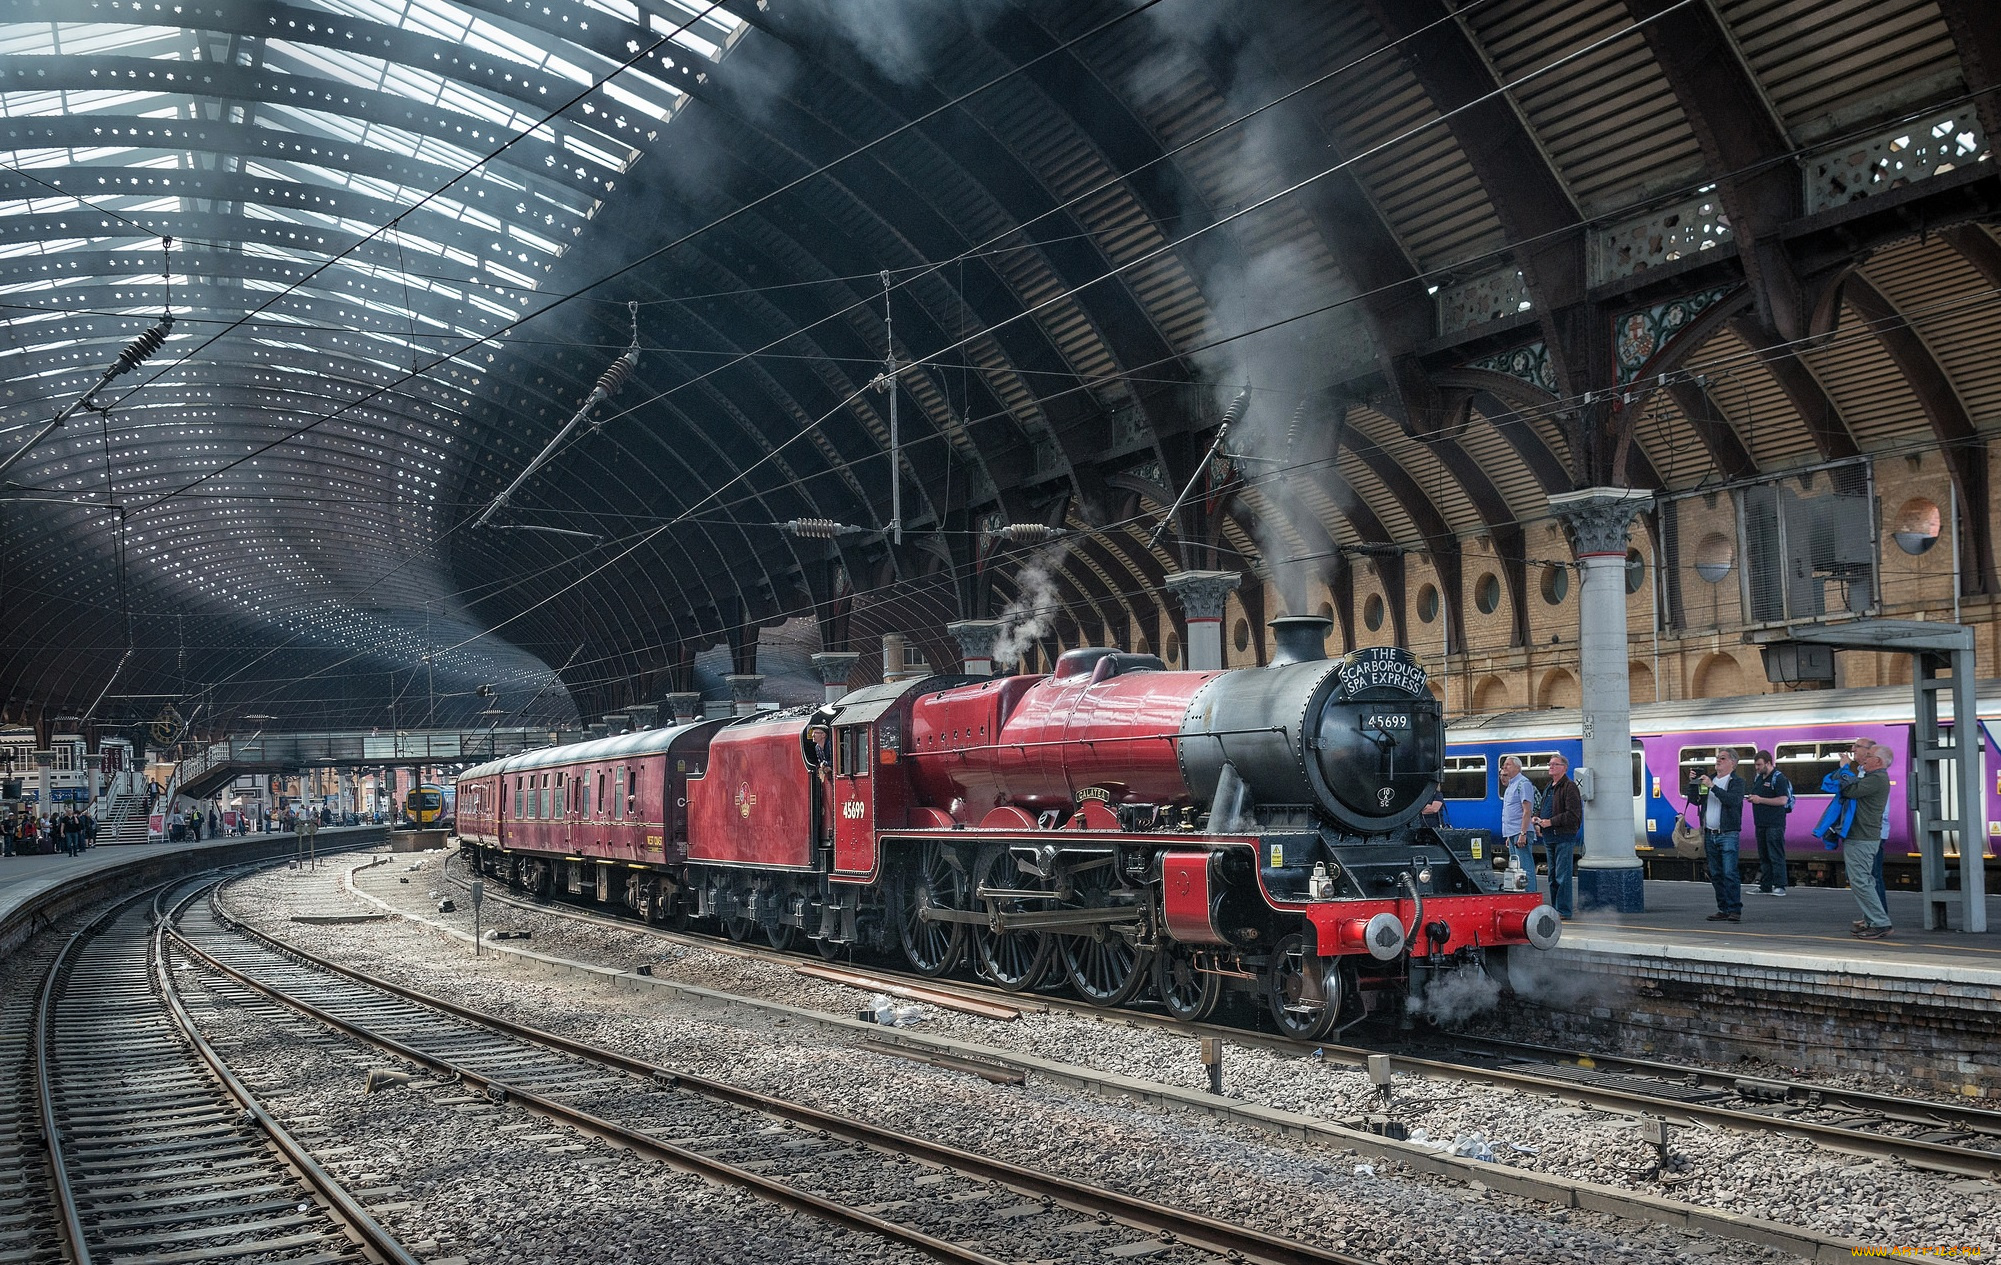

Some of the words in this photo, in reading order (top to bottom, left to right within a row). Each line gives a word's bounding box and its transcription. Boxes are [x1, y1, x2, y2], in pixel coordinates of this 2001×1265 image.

[1371, 648, 1396, 660] THE
[1341, 660, 1427, 685] SCARBOROUGH
[1347, 676, 1368, 693] SPA
[1371, 672, 1420, 694] EXPRESS
[1368, 715, 1407, 728] 45699
[1079, 788, 1106, 799] GALATEA
[843, 801, 865, 819] 45699
